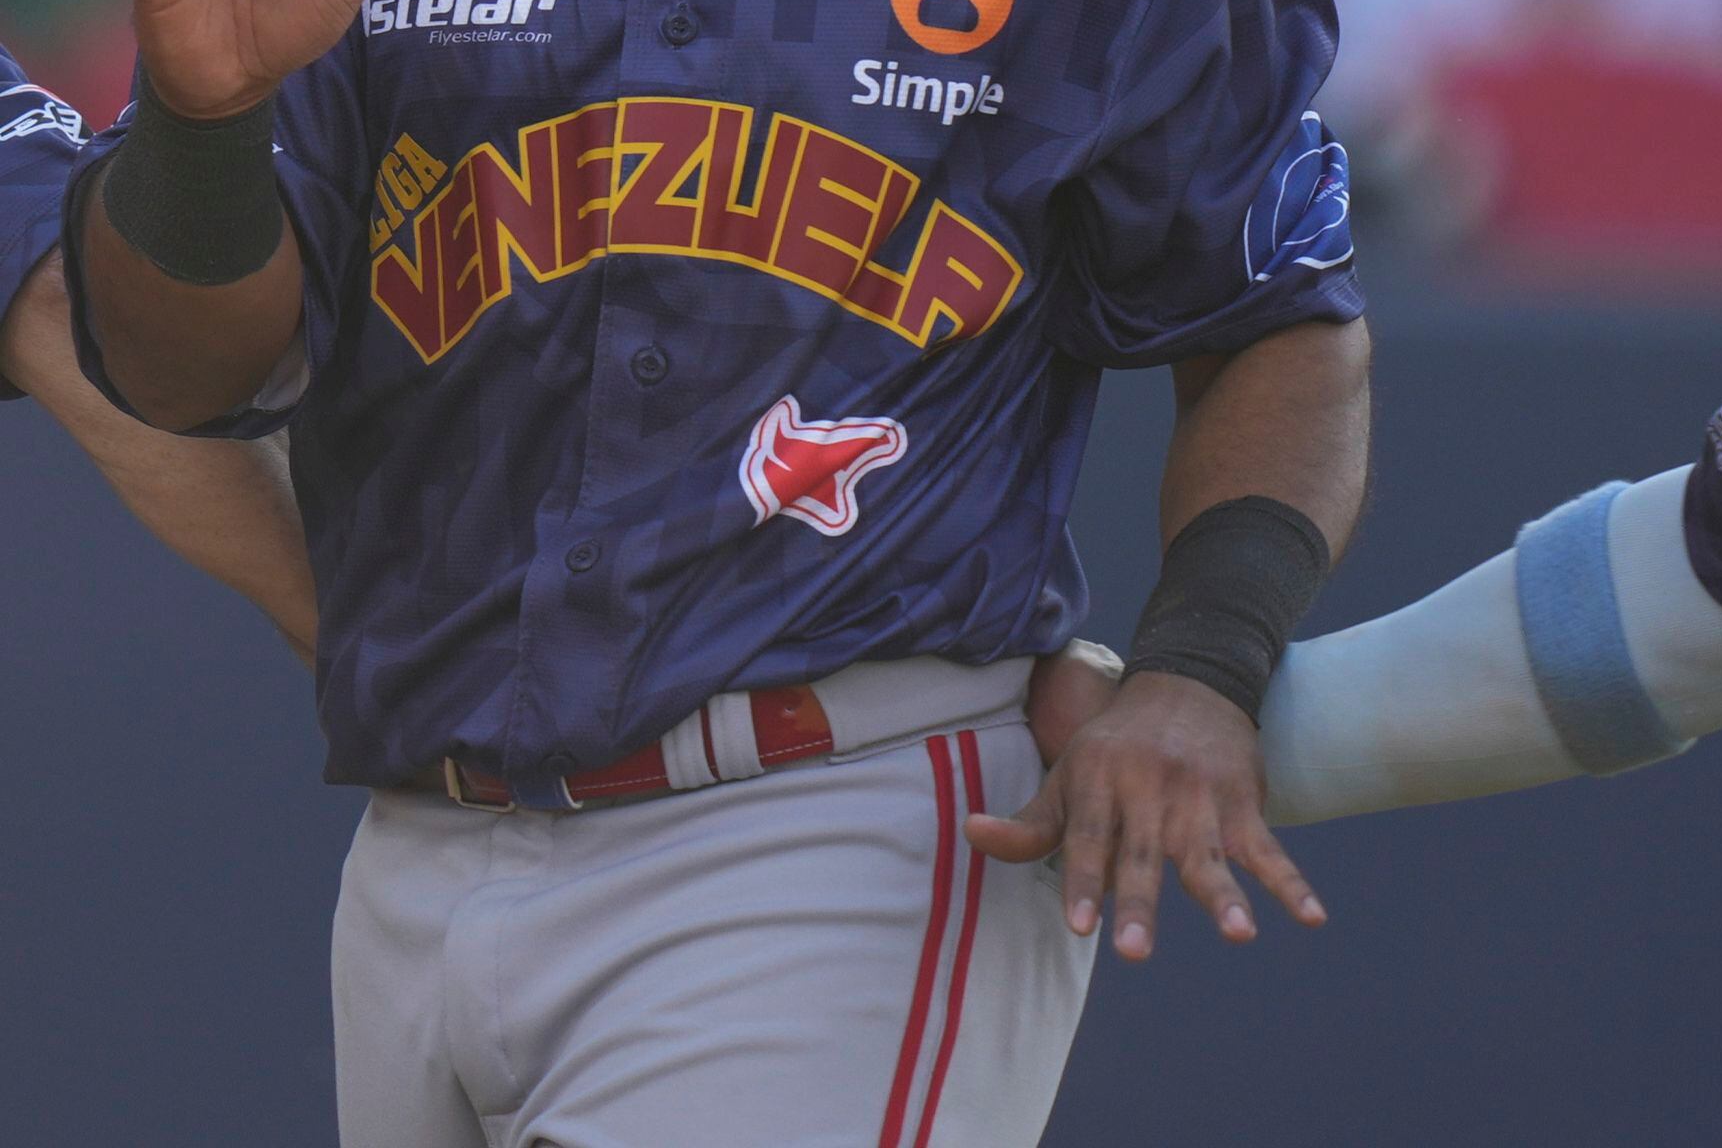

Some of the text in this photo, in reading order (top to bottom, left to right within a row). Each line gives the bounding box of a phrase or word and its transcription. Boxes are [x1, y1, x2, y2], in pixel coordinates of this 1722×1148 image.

[851, 58, 1004, 126] Simple
[369, 131, 449, 254] LIGA
[370, 96, 1025, 366] VENEZUELA
